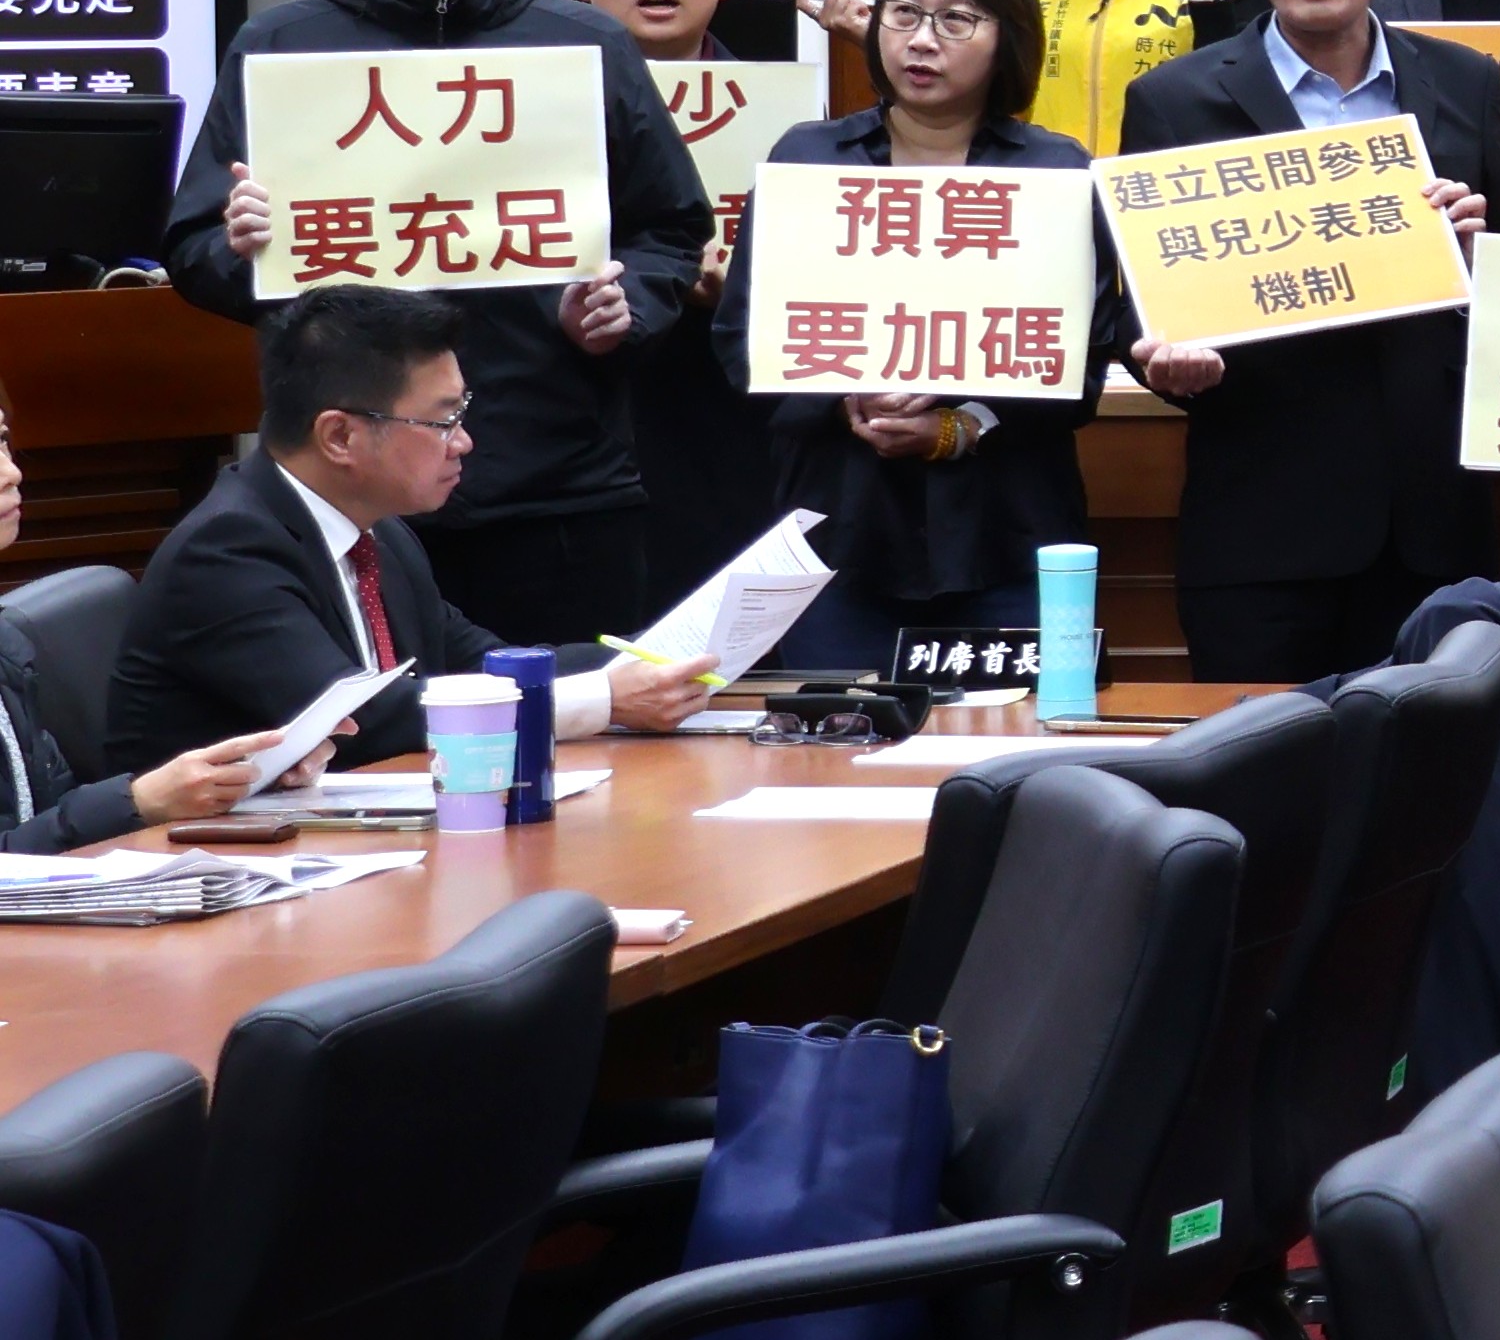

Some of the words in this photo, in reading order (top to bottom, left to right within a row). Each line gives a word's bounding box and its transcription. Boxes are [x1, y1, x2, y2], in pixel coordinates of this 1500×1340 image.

[1135, 37, 1177, 56] 時代
[336, 65, 516, 150] 人力
[1112, 132, 1416, 213] 建立民間參與
[290, 188, 577, 282] 要充足
[837, 177, 1021, 261] 預算
[1158, 195, 1412, 267] 與兒少表意
[1252, 262, 1355, 315] 機制
[781, 301, 1065, 386] 要加碼
[908, 641, 1040, 674] 列席首長
